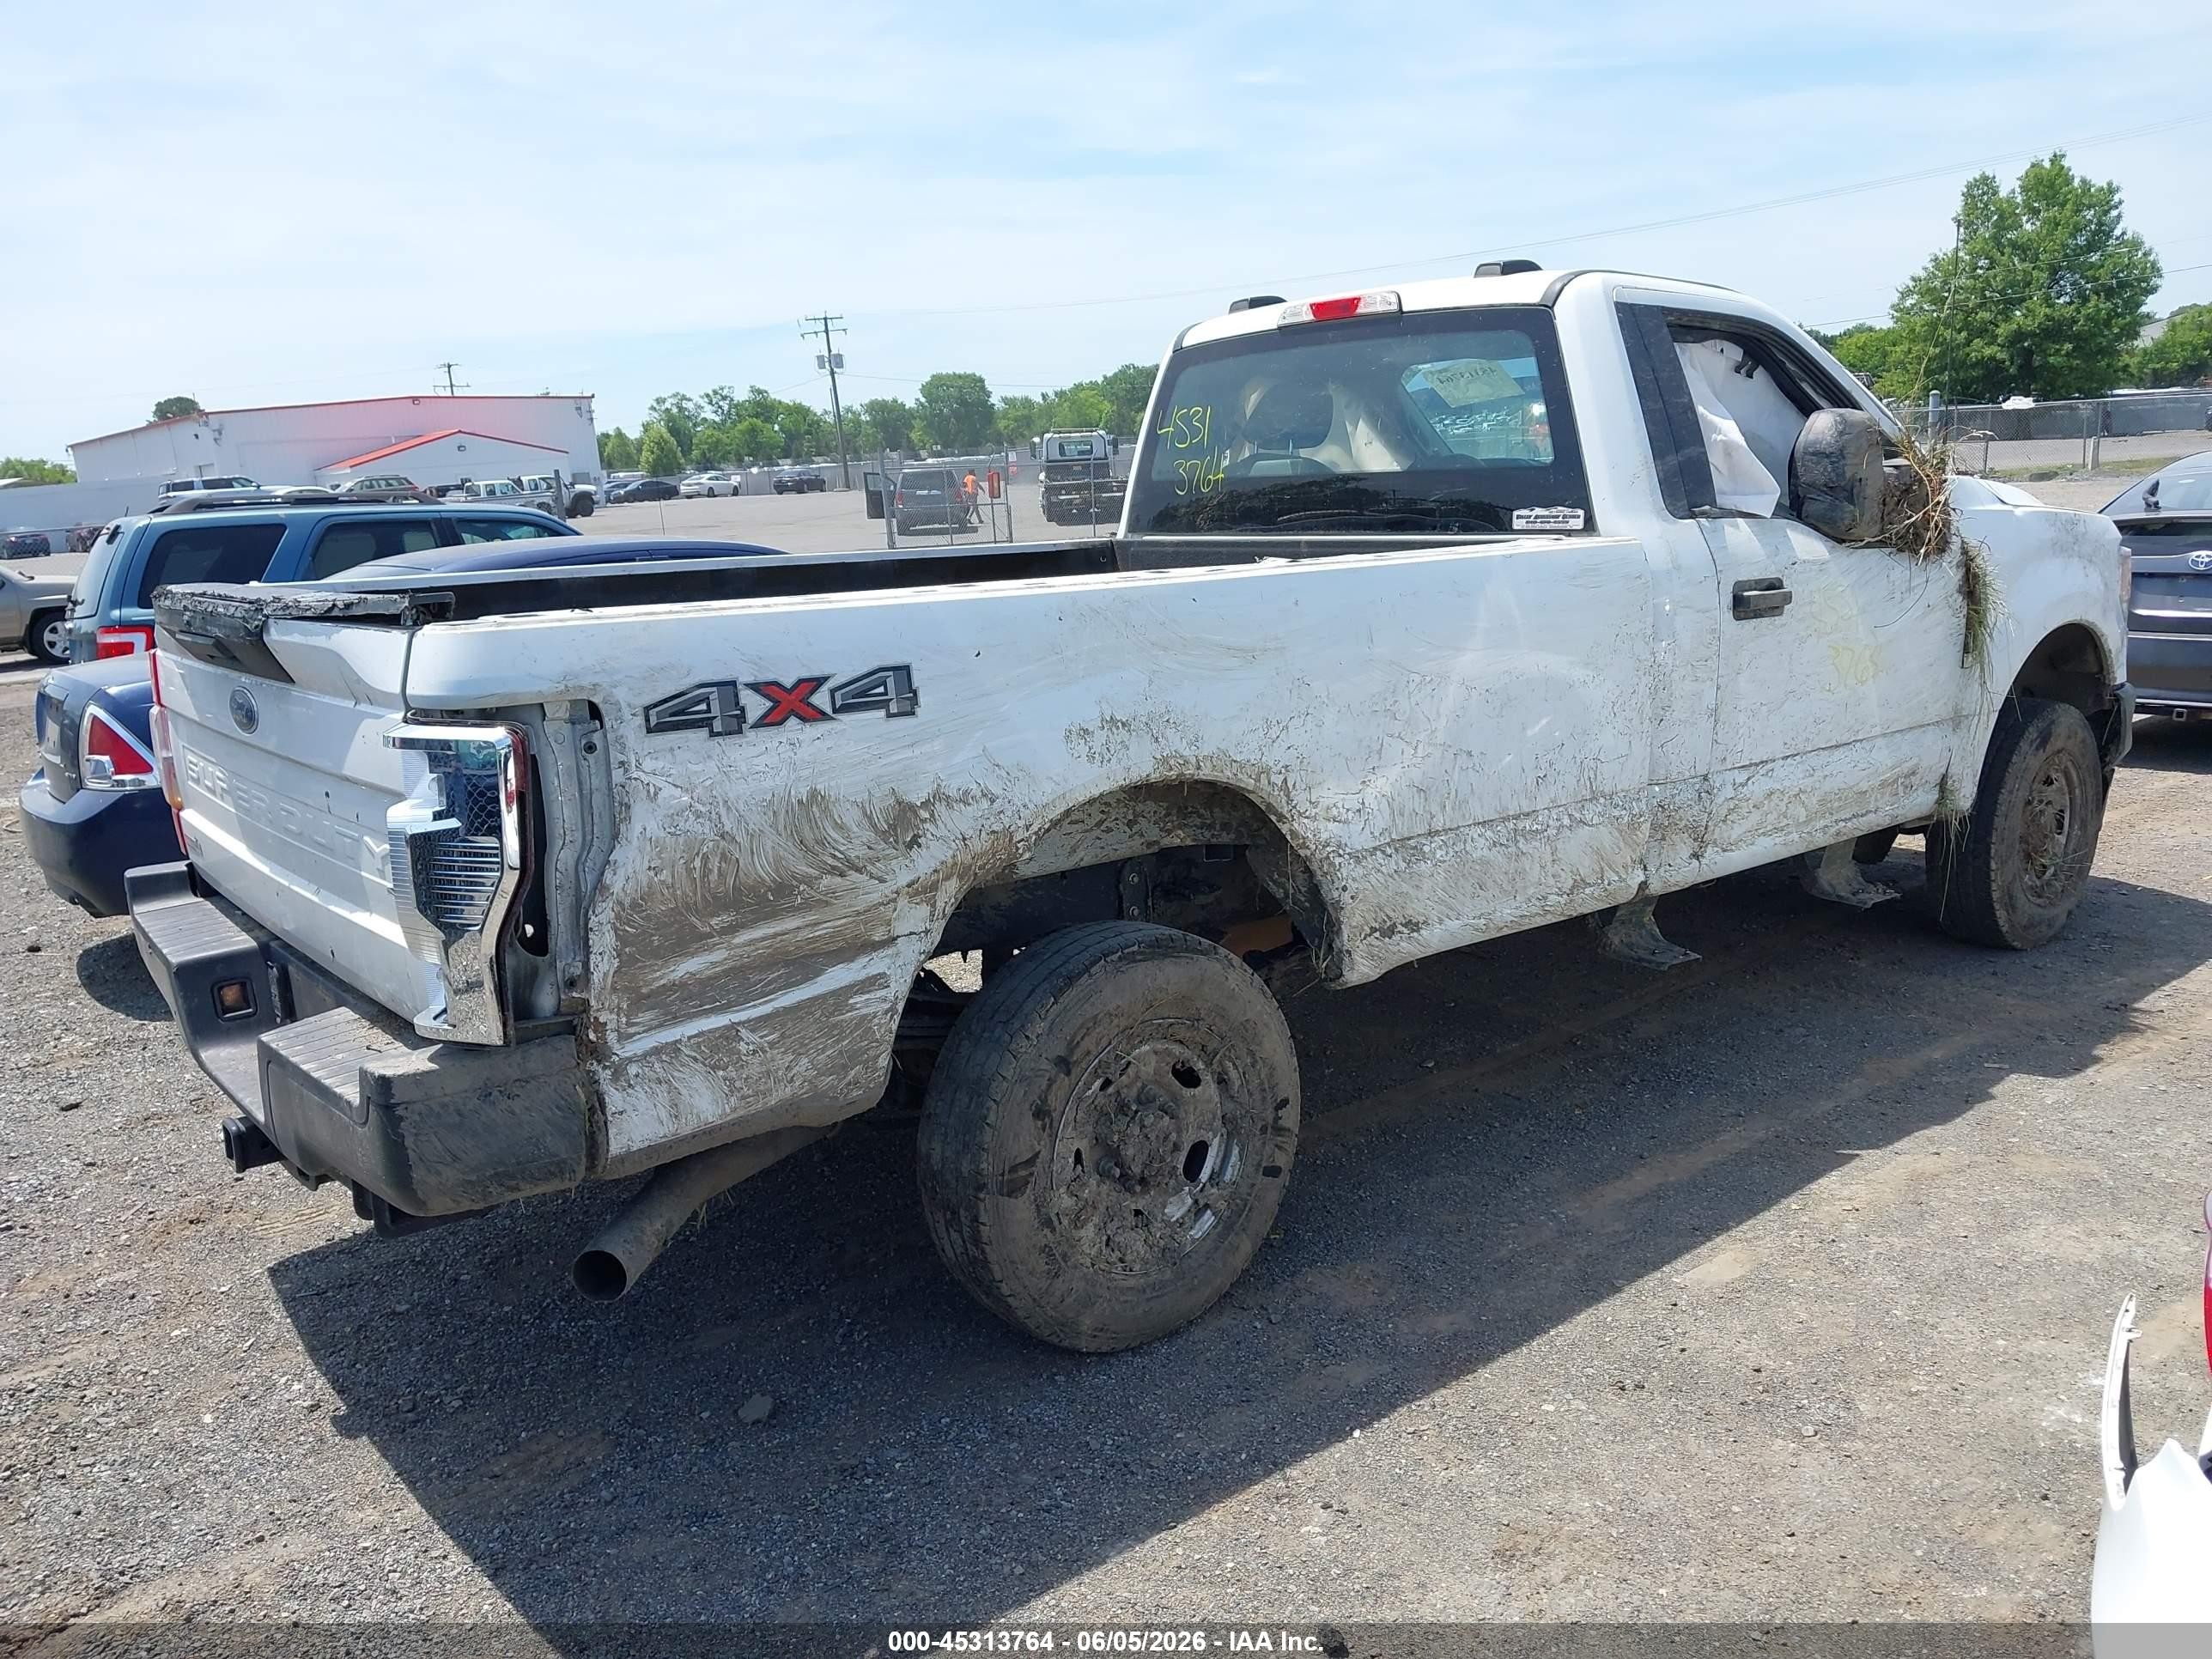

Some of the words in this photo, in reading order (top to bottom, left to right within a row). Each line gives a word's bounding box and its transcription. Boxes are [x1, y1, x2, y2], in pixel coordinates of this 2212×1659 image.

[1157, 405, 1210, 449] 4531
[1173, 446, 1224, 495] 3764
[643, 662, 921, 738] 4X4
[277, 800, 391, 874] DUTY
